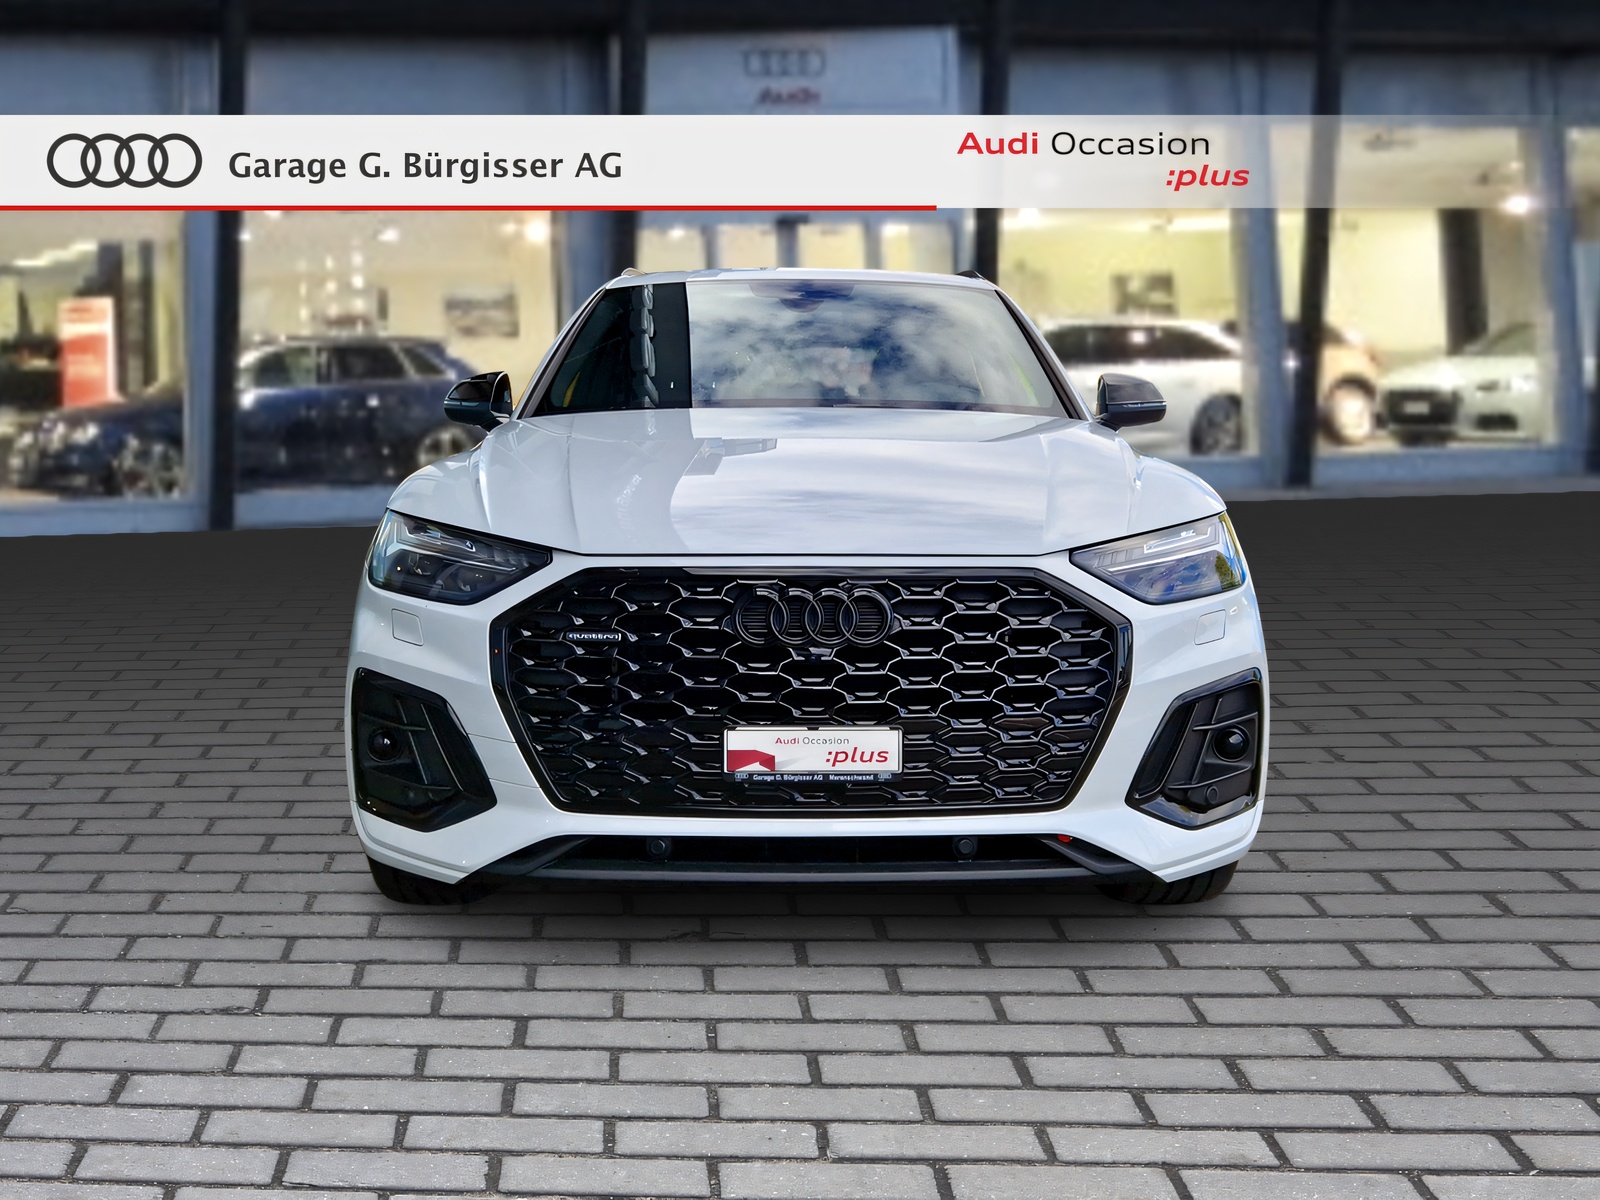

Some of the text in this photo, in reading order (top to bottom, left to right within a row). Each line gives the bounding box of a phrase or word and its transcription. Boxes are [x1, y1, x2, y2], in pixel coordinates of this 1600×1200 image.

[775, 736, 850, 745] Audi Occasion
[825, 746, 889, 767] :plus
[753, 774, 775, 782] Garage
